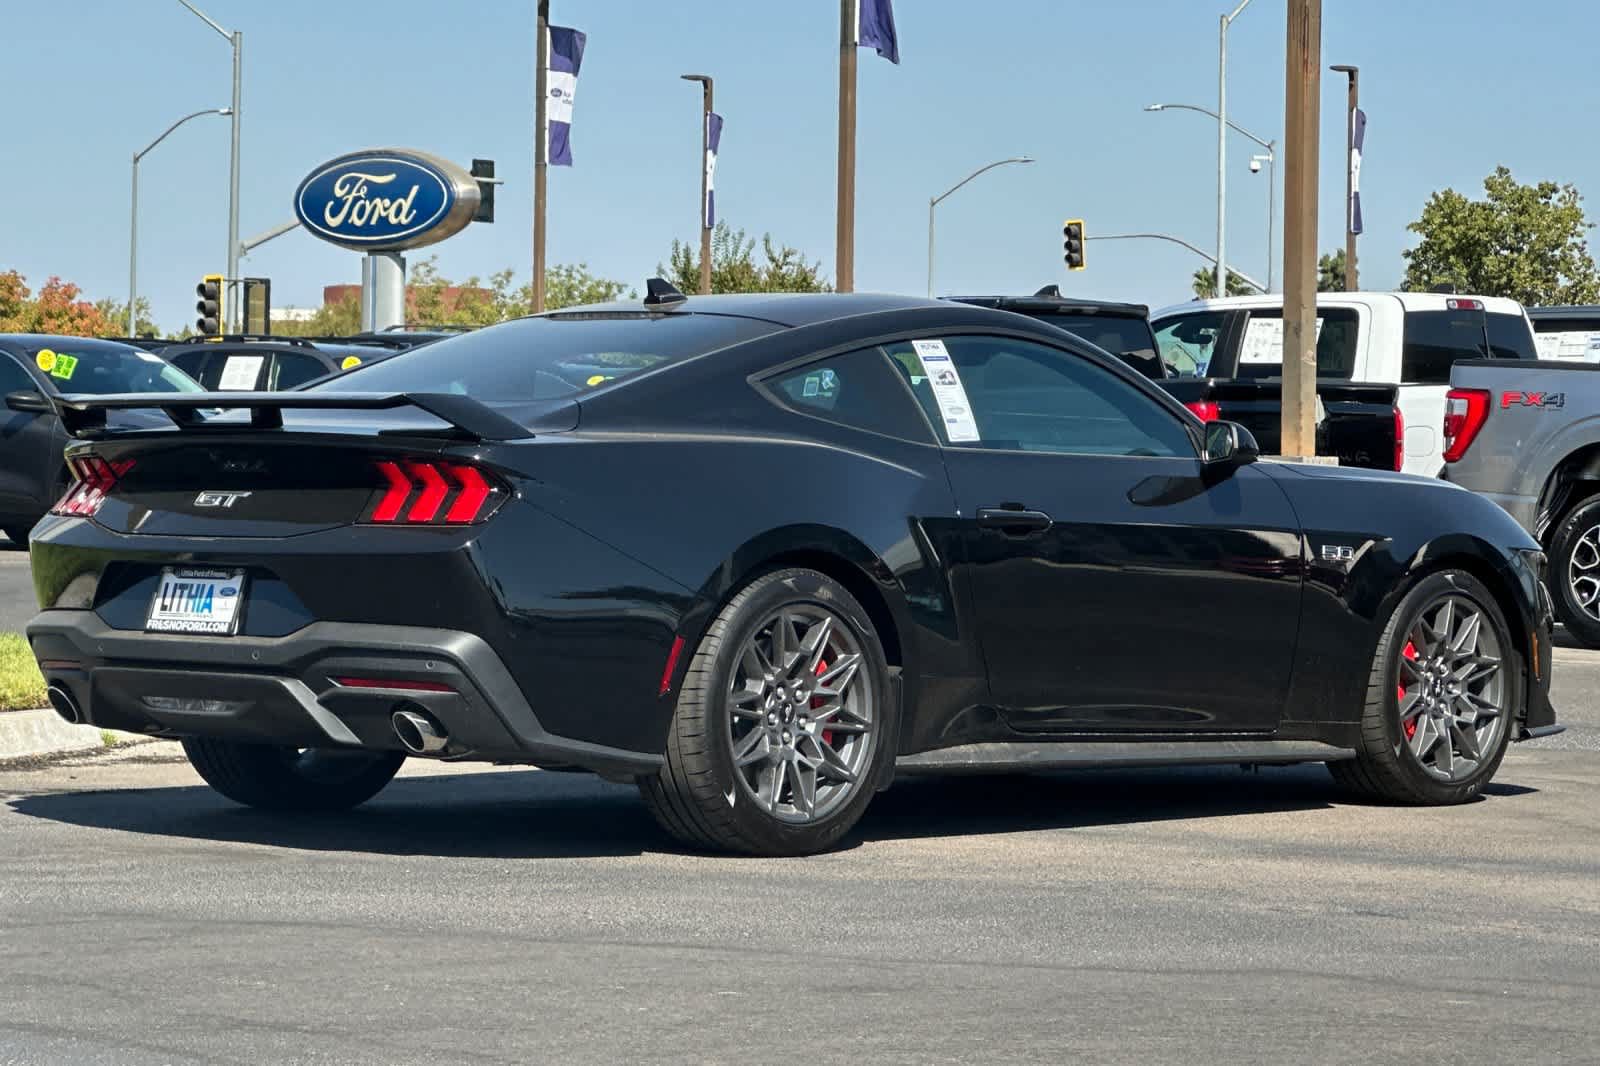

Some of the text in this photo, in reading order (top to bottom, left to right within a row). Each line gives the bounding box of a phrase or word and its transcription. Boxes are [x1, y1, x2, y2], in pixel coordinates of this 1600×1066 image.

[324, 172, 420, 227] Ford
[1501, 391, 1565, 409] FX4
[193, 490, 253, 508] GT
[160, 582, 215, 613] LITHIA
[146, 619, 229, 633] FRESNOFORD.COM
